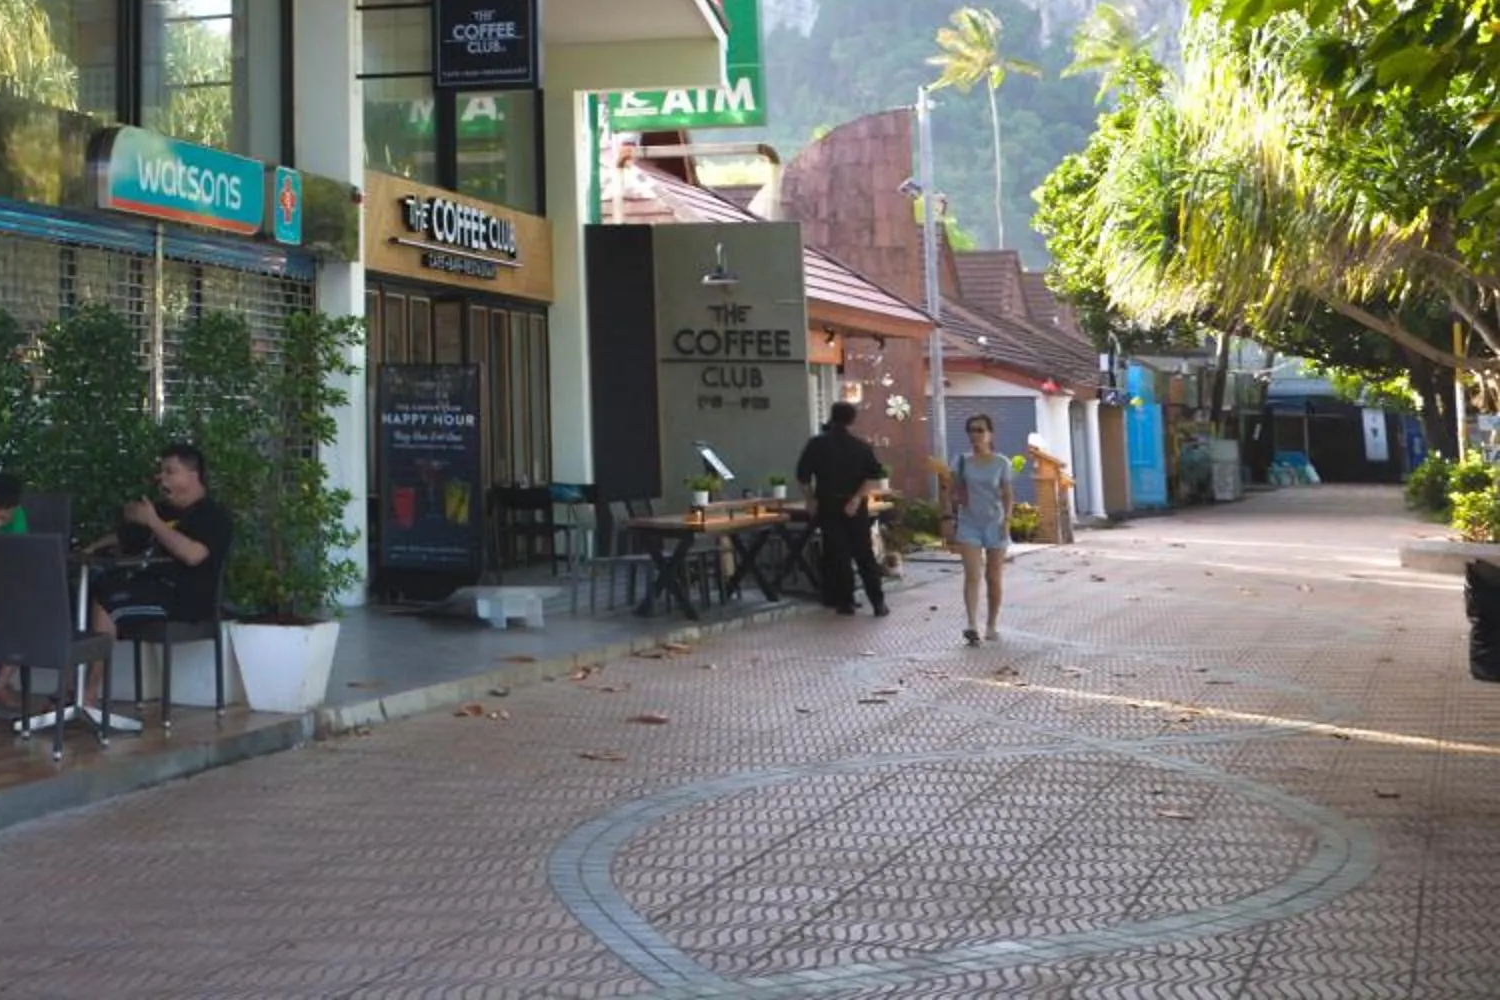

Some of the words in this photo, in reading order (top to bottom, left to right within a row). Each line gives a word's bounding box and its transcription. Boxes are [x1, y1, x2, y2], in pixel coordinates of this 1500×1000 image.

[452, 22, 516, 40] COFFEE
[467, 40, 501, 53] CLUB
[137, 153, 241, 210] watsons
[404, 197, 430, 232] THE
[432, 198, 488, 250] COFFEE
[489, 217, 516, 254] CLUB
[708, 304, 752, 326] THE
[673, 328, 791, 357] COFFEE
[702, 366, 763, 388] CLUB
[381, 412, 427, 425] HAPPY
[433, 412, 475, 426] HOUR
